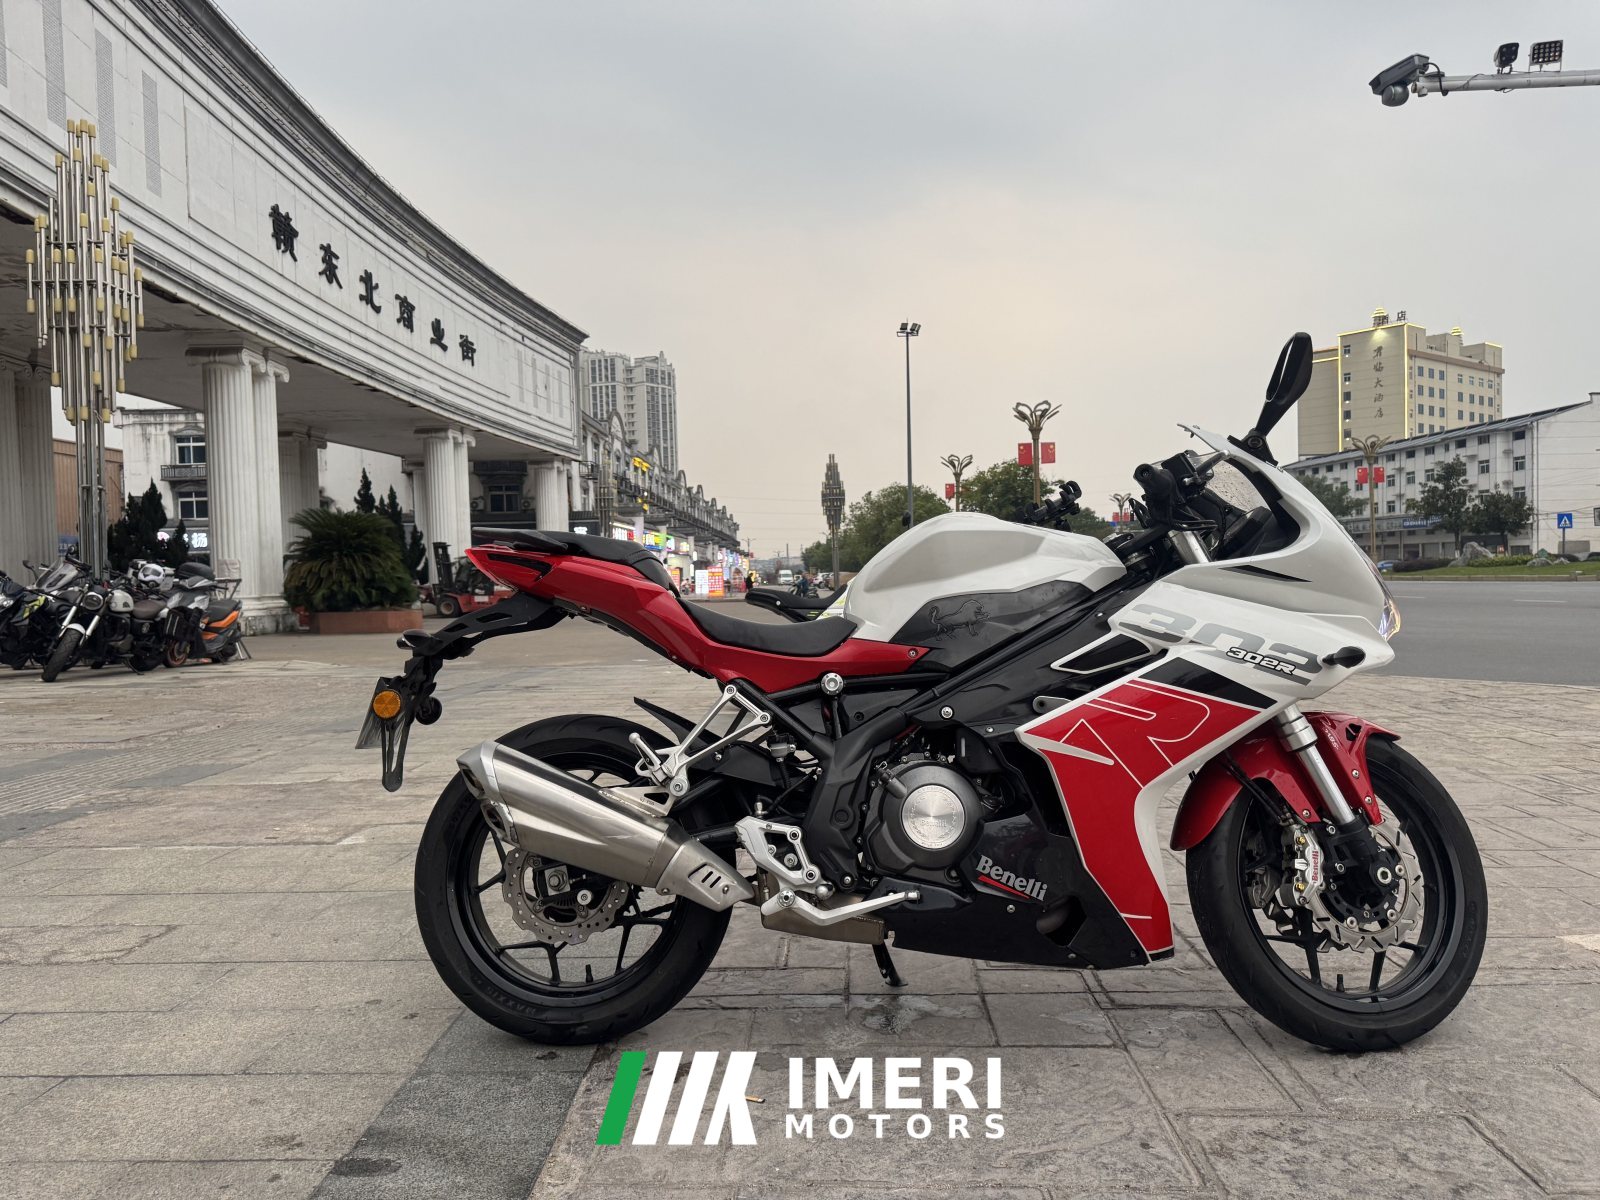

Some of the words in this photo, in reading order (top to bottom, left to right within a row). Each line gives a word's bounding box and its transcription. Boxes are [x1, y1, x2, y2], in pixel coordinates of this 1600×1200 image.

[1226, 646, 1296, 676] 302R
[976, 855, 1048, 901] Benelli
[1311, 850, 1319, 881] Benelli
